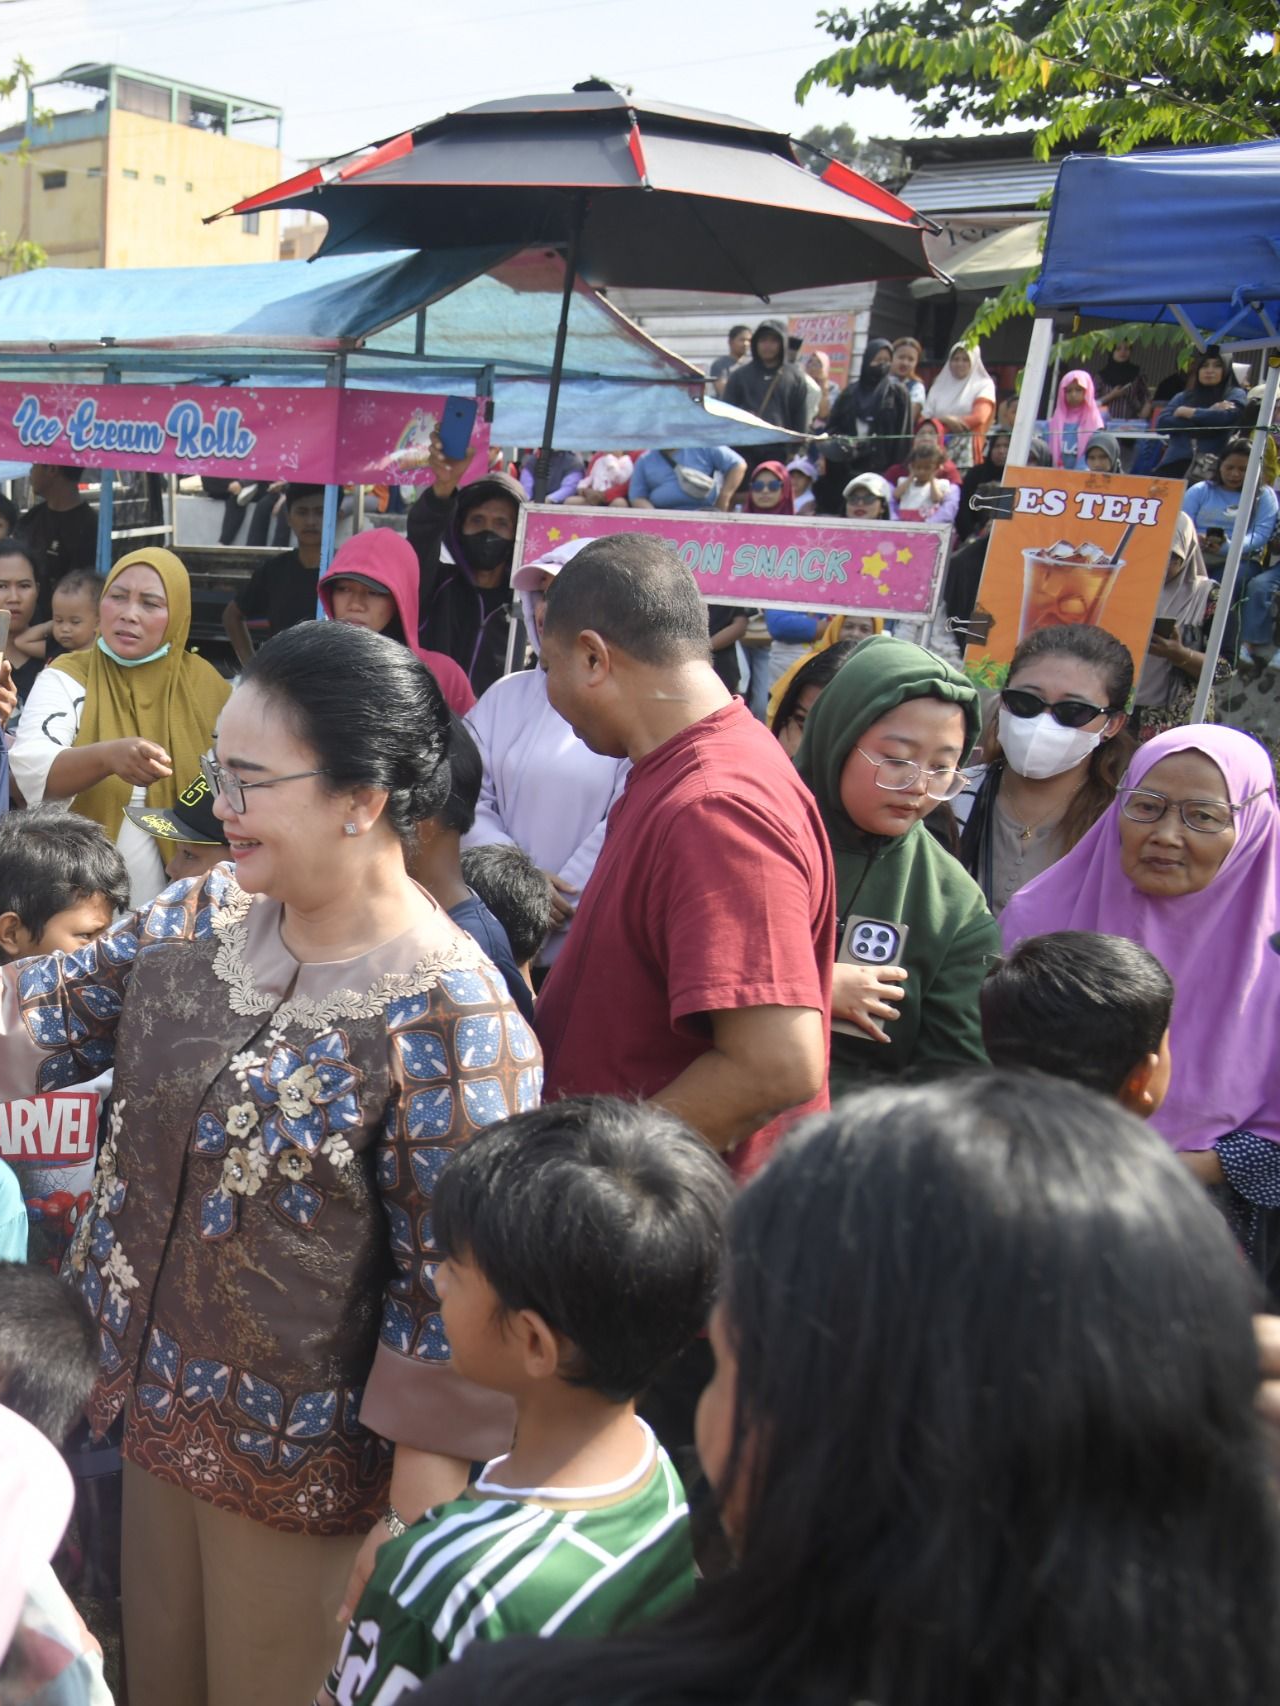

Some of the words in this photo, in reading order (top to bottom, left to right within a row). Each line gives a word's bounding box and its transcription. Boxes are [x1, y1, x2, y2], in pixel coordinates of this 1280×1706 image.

[13, 395, 64, 447] Ice
[66, 397, 165, 454] Cream
[167, 400, 256, 459] Rolls
[1014, 487, 1068, 517] ES
[1073, 492, 1164, 527] TEH
[731, 543, 853, 585] SNACK
